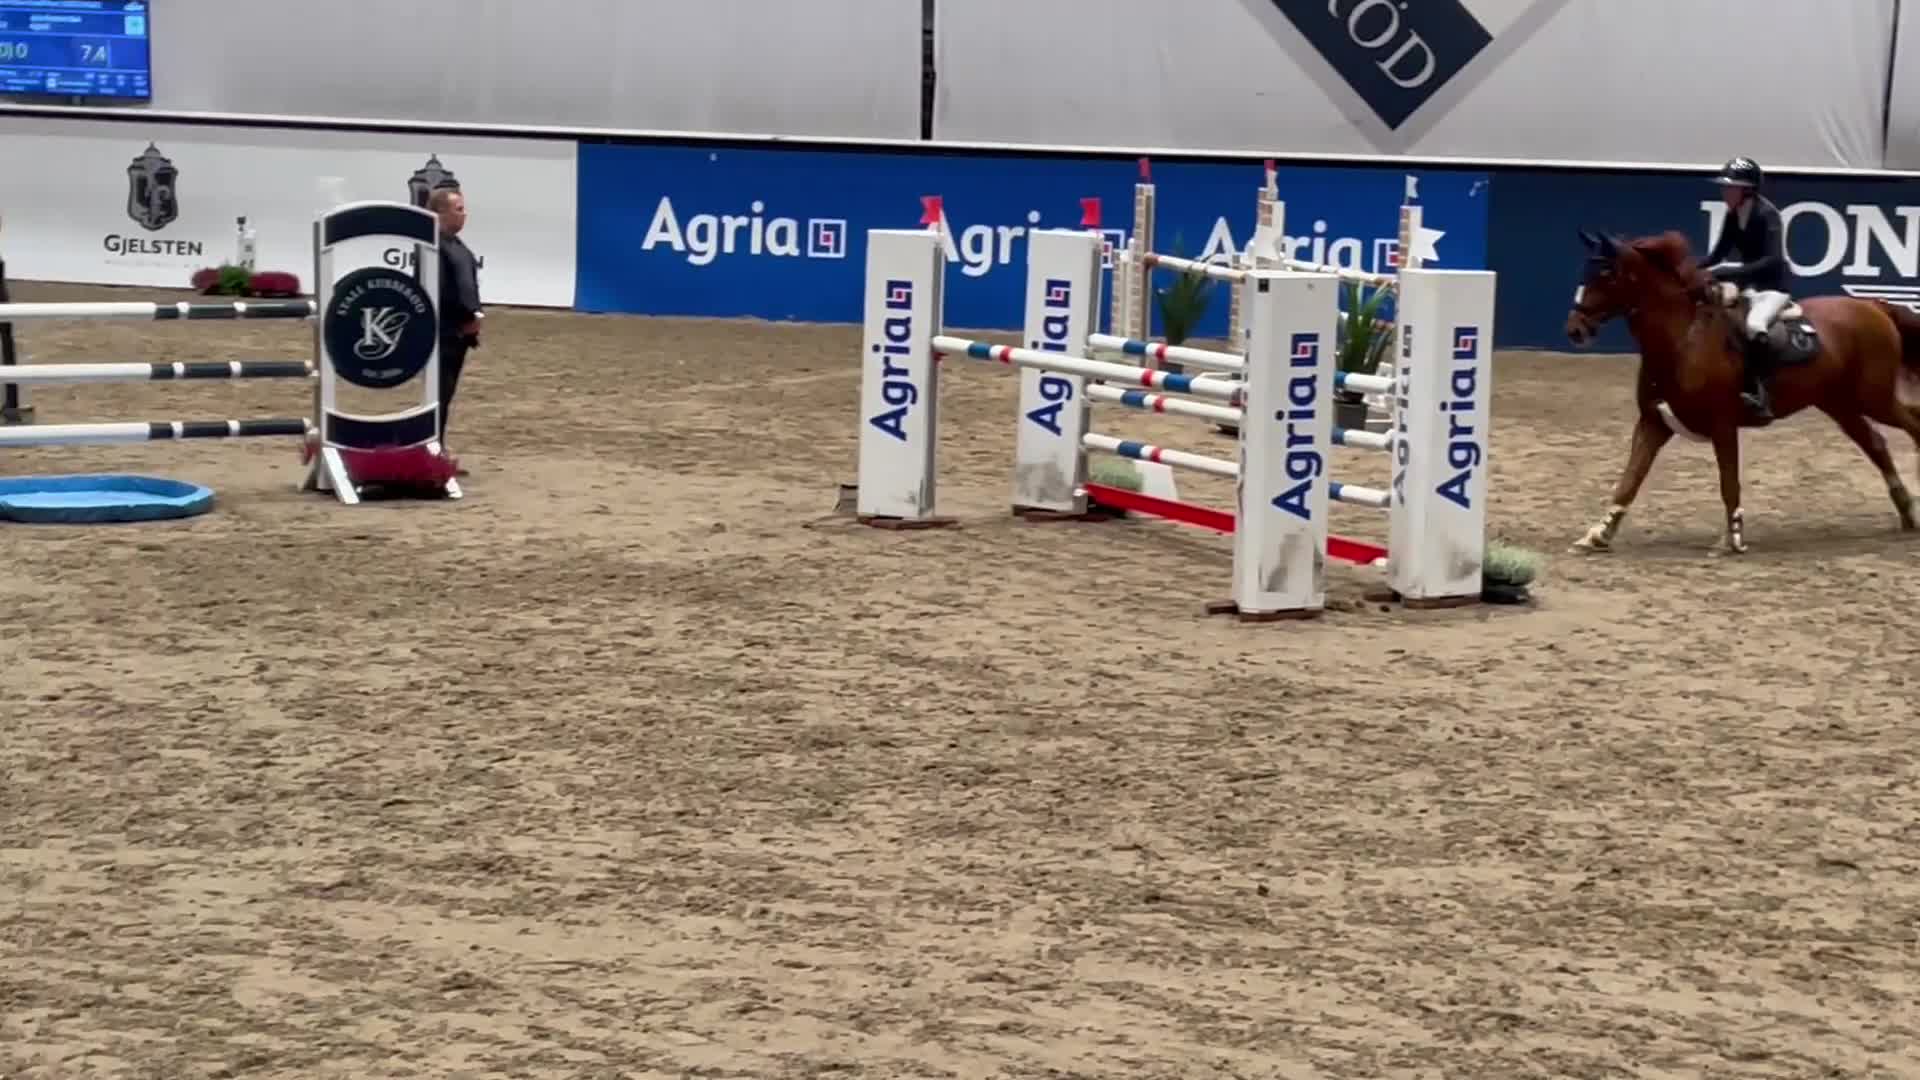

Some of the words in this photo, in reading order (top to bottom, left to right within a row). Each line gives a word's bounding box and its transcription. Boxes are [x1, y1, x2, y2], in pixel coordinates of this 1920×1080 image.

[1328, 0, 1436, 88] ÖD
[103, 234, 203, 256] GJELSTEN
[641, 196, 800, 266] Agria
[928, 207, 1072, 277] Agr
[1195, 216, 1363, 275] Aria
[869, 316, 918, 442] Agria
[1026, 315, 1073, 437] Agia
[1271, 373, 1323, 521] Agria
[1435, 367, 1482, 510] Agria
